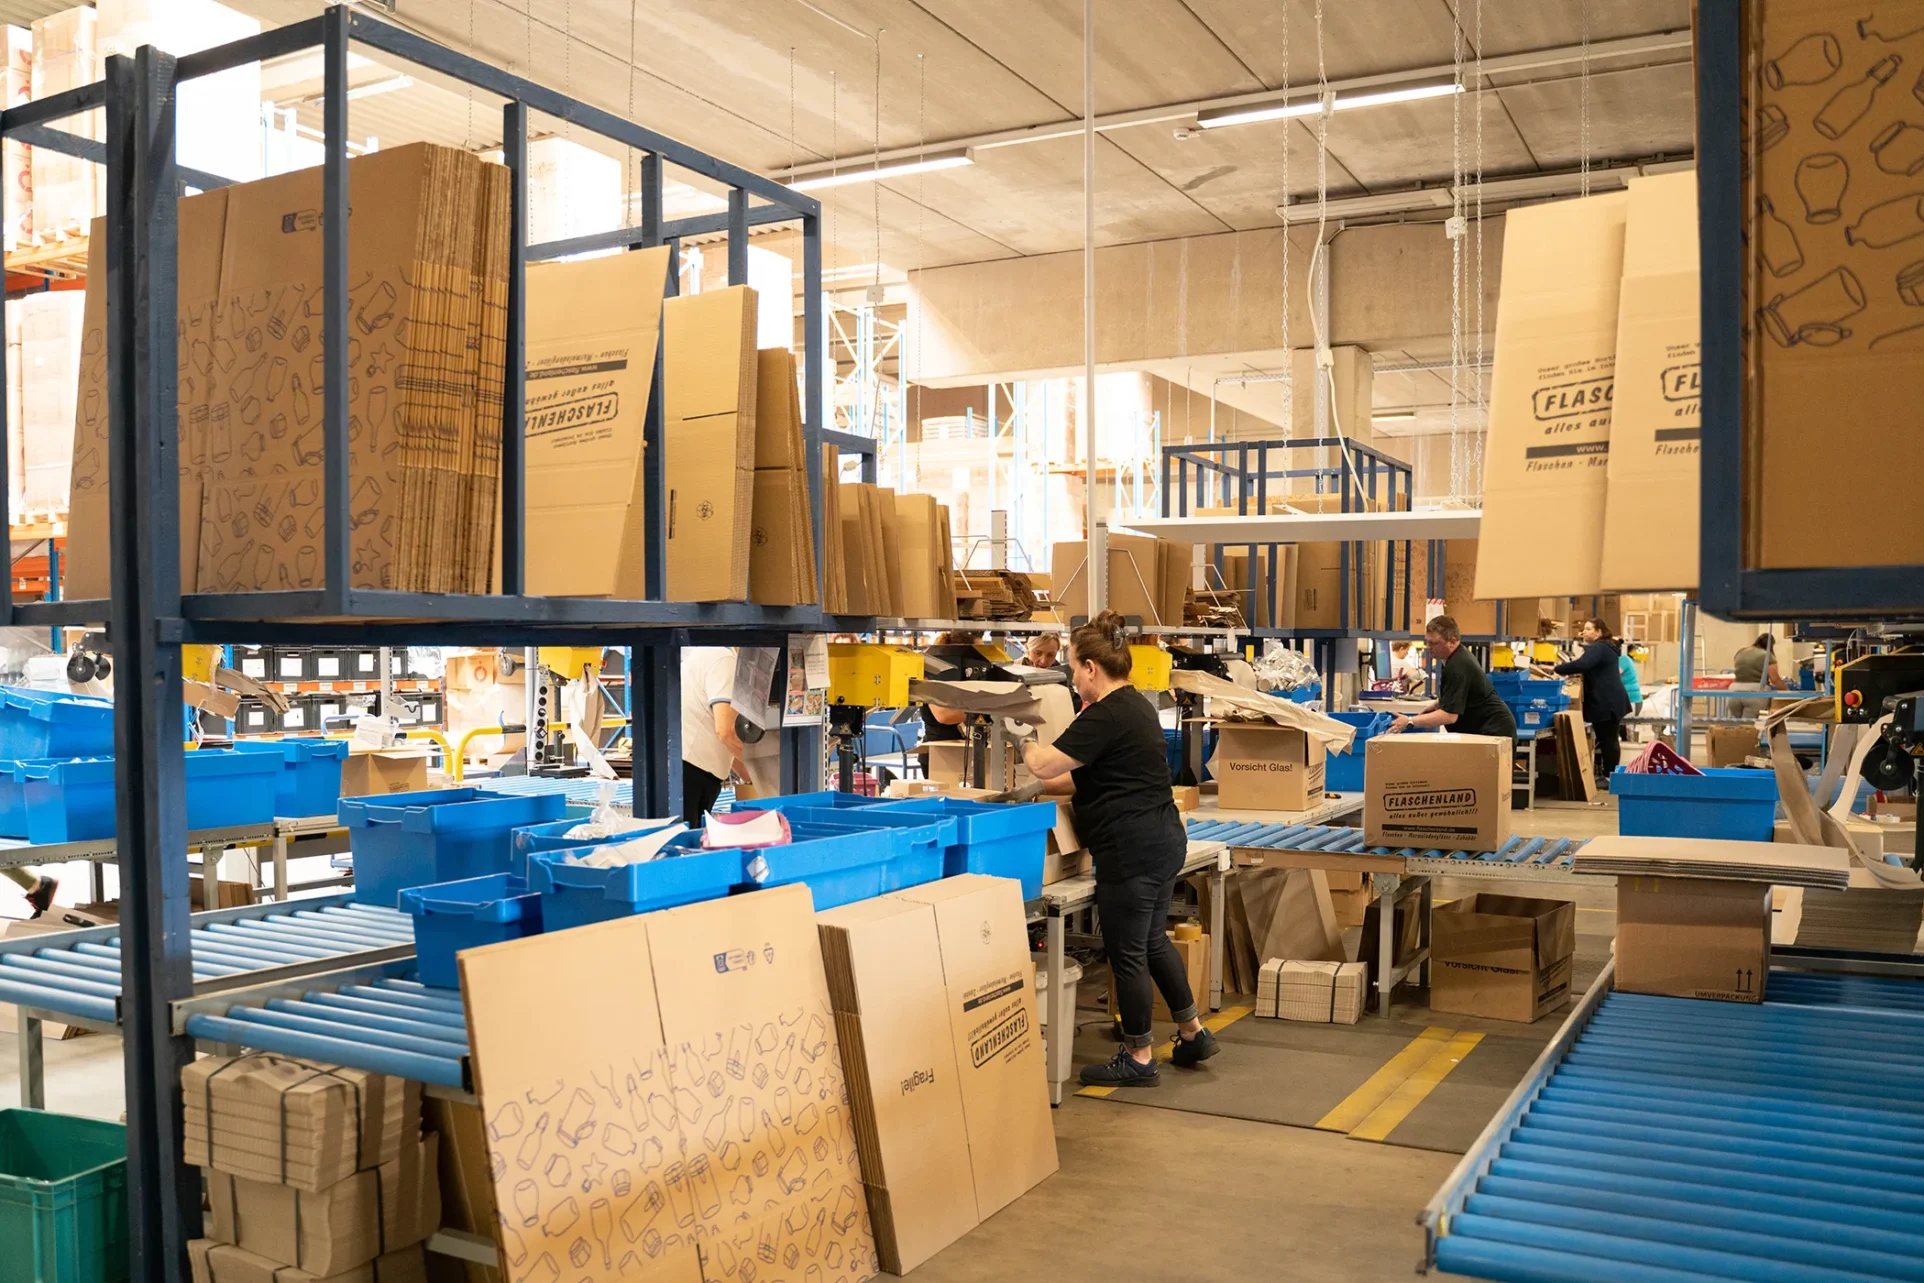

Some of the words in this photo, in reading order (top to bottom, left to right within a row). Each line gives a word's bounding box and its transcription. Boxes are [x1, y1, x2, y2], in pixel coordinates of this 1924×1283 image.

[562, 386, 588, 397] außer
[592, 380, 614, 391] alles
[1674, 402, 1701, 417] all
[1544, 421, 1582, 435] alles
[1589, 417, 1612, 427] au
[1576, 444, 1608, 453] www.
[1525, 458, 1573, 472] Flaschen
[1229, 762, 1267, 772] Vorsicht
[1269, 763, 1293, 772] Glas!
[1388, 792, 1472, 807] FLASCHENLAND
[1388, 811, 1406, 820] alles
[1408, 810, 1428, 819] außer
[1430, 808, 1479, 819] gewöhnlich!!!
[974, 1014, 1026, 1061] FLASCHENLAND
[900, 1068, 935, 1097] Fragile!
